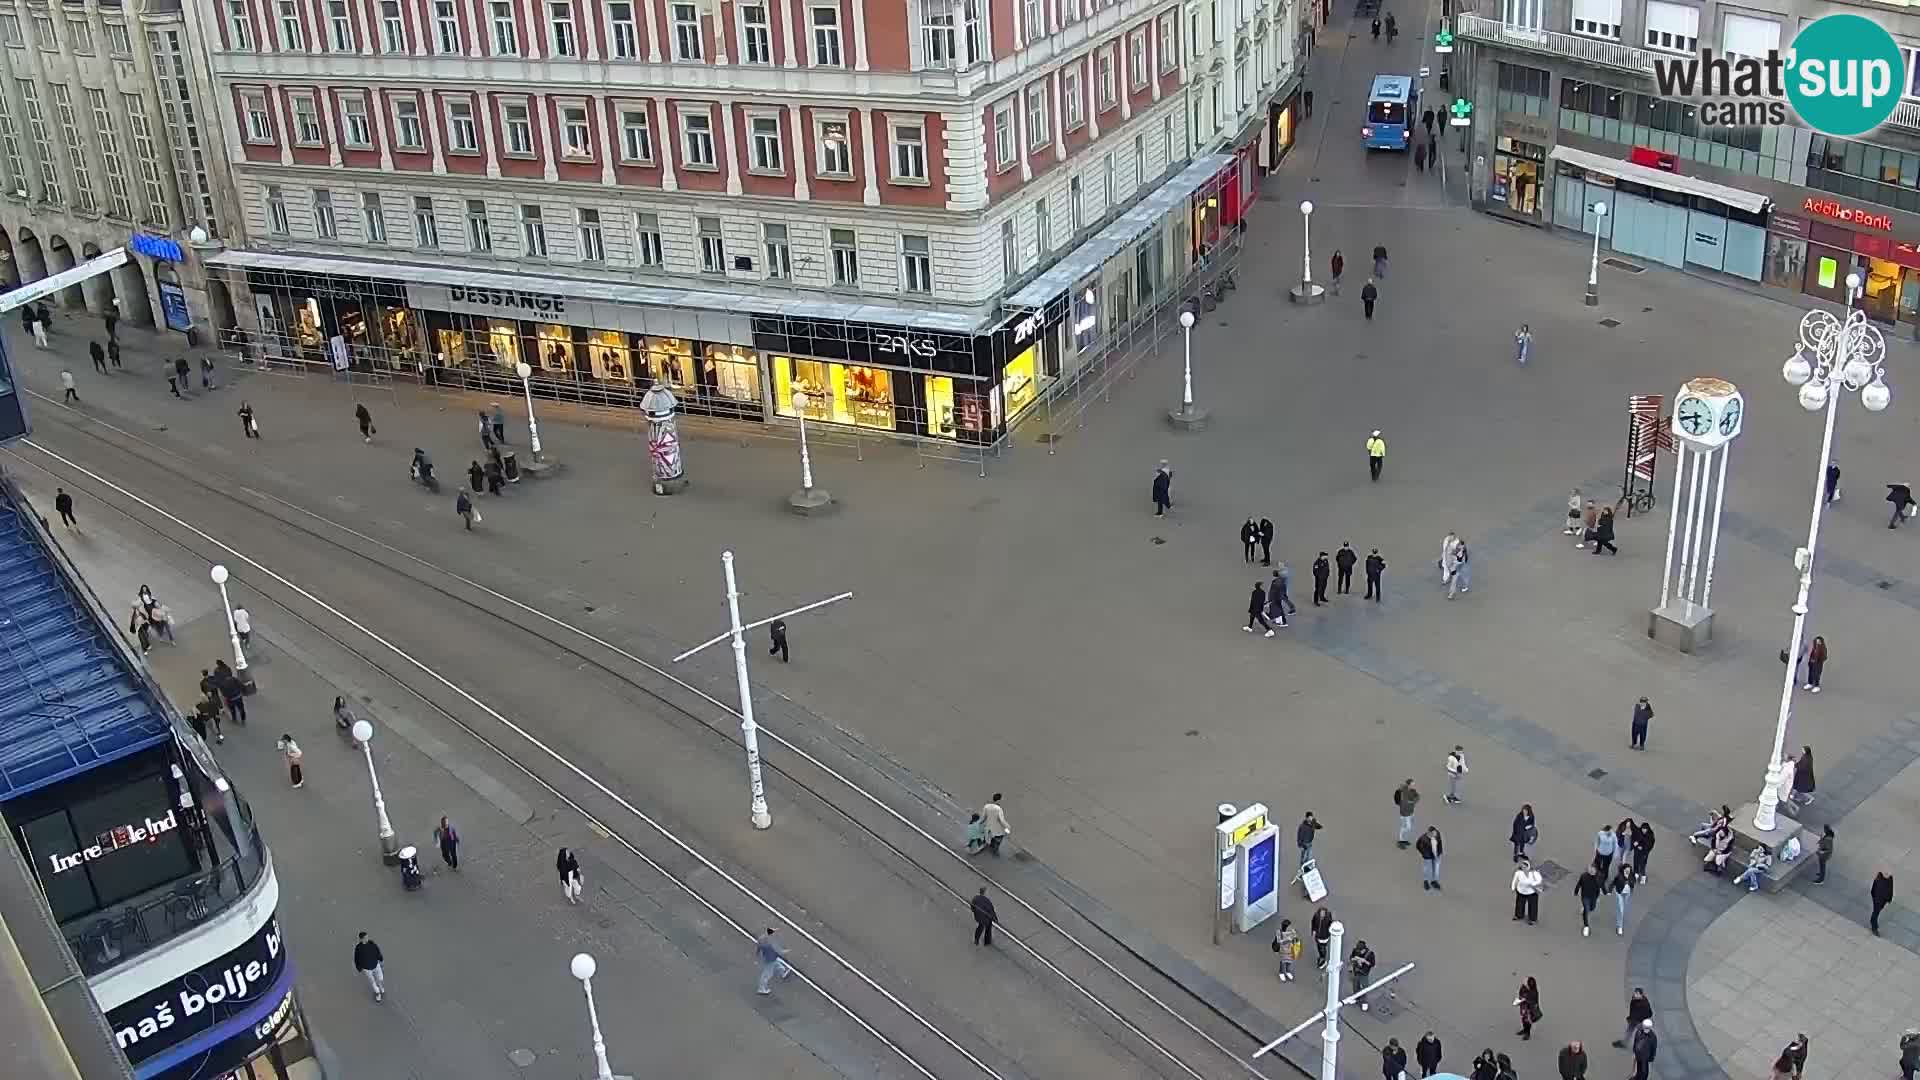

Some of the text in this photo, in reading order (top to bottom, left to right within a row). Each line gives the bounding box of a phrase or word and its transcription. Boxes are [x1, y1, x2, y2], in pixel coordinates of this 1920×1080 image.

[1804, 198, 1893, 232] Addiko Bank
[451, 285, 565, 313] DESSANGE
[1014, 308, 1045, 345] ZAKS
[876, 333, 937, 357] ZAKS
[115, 1001, 175, 1048] naš
[180, 959, 267, 1016] bolje,
